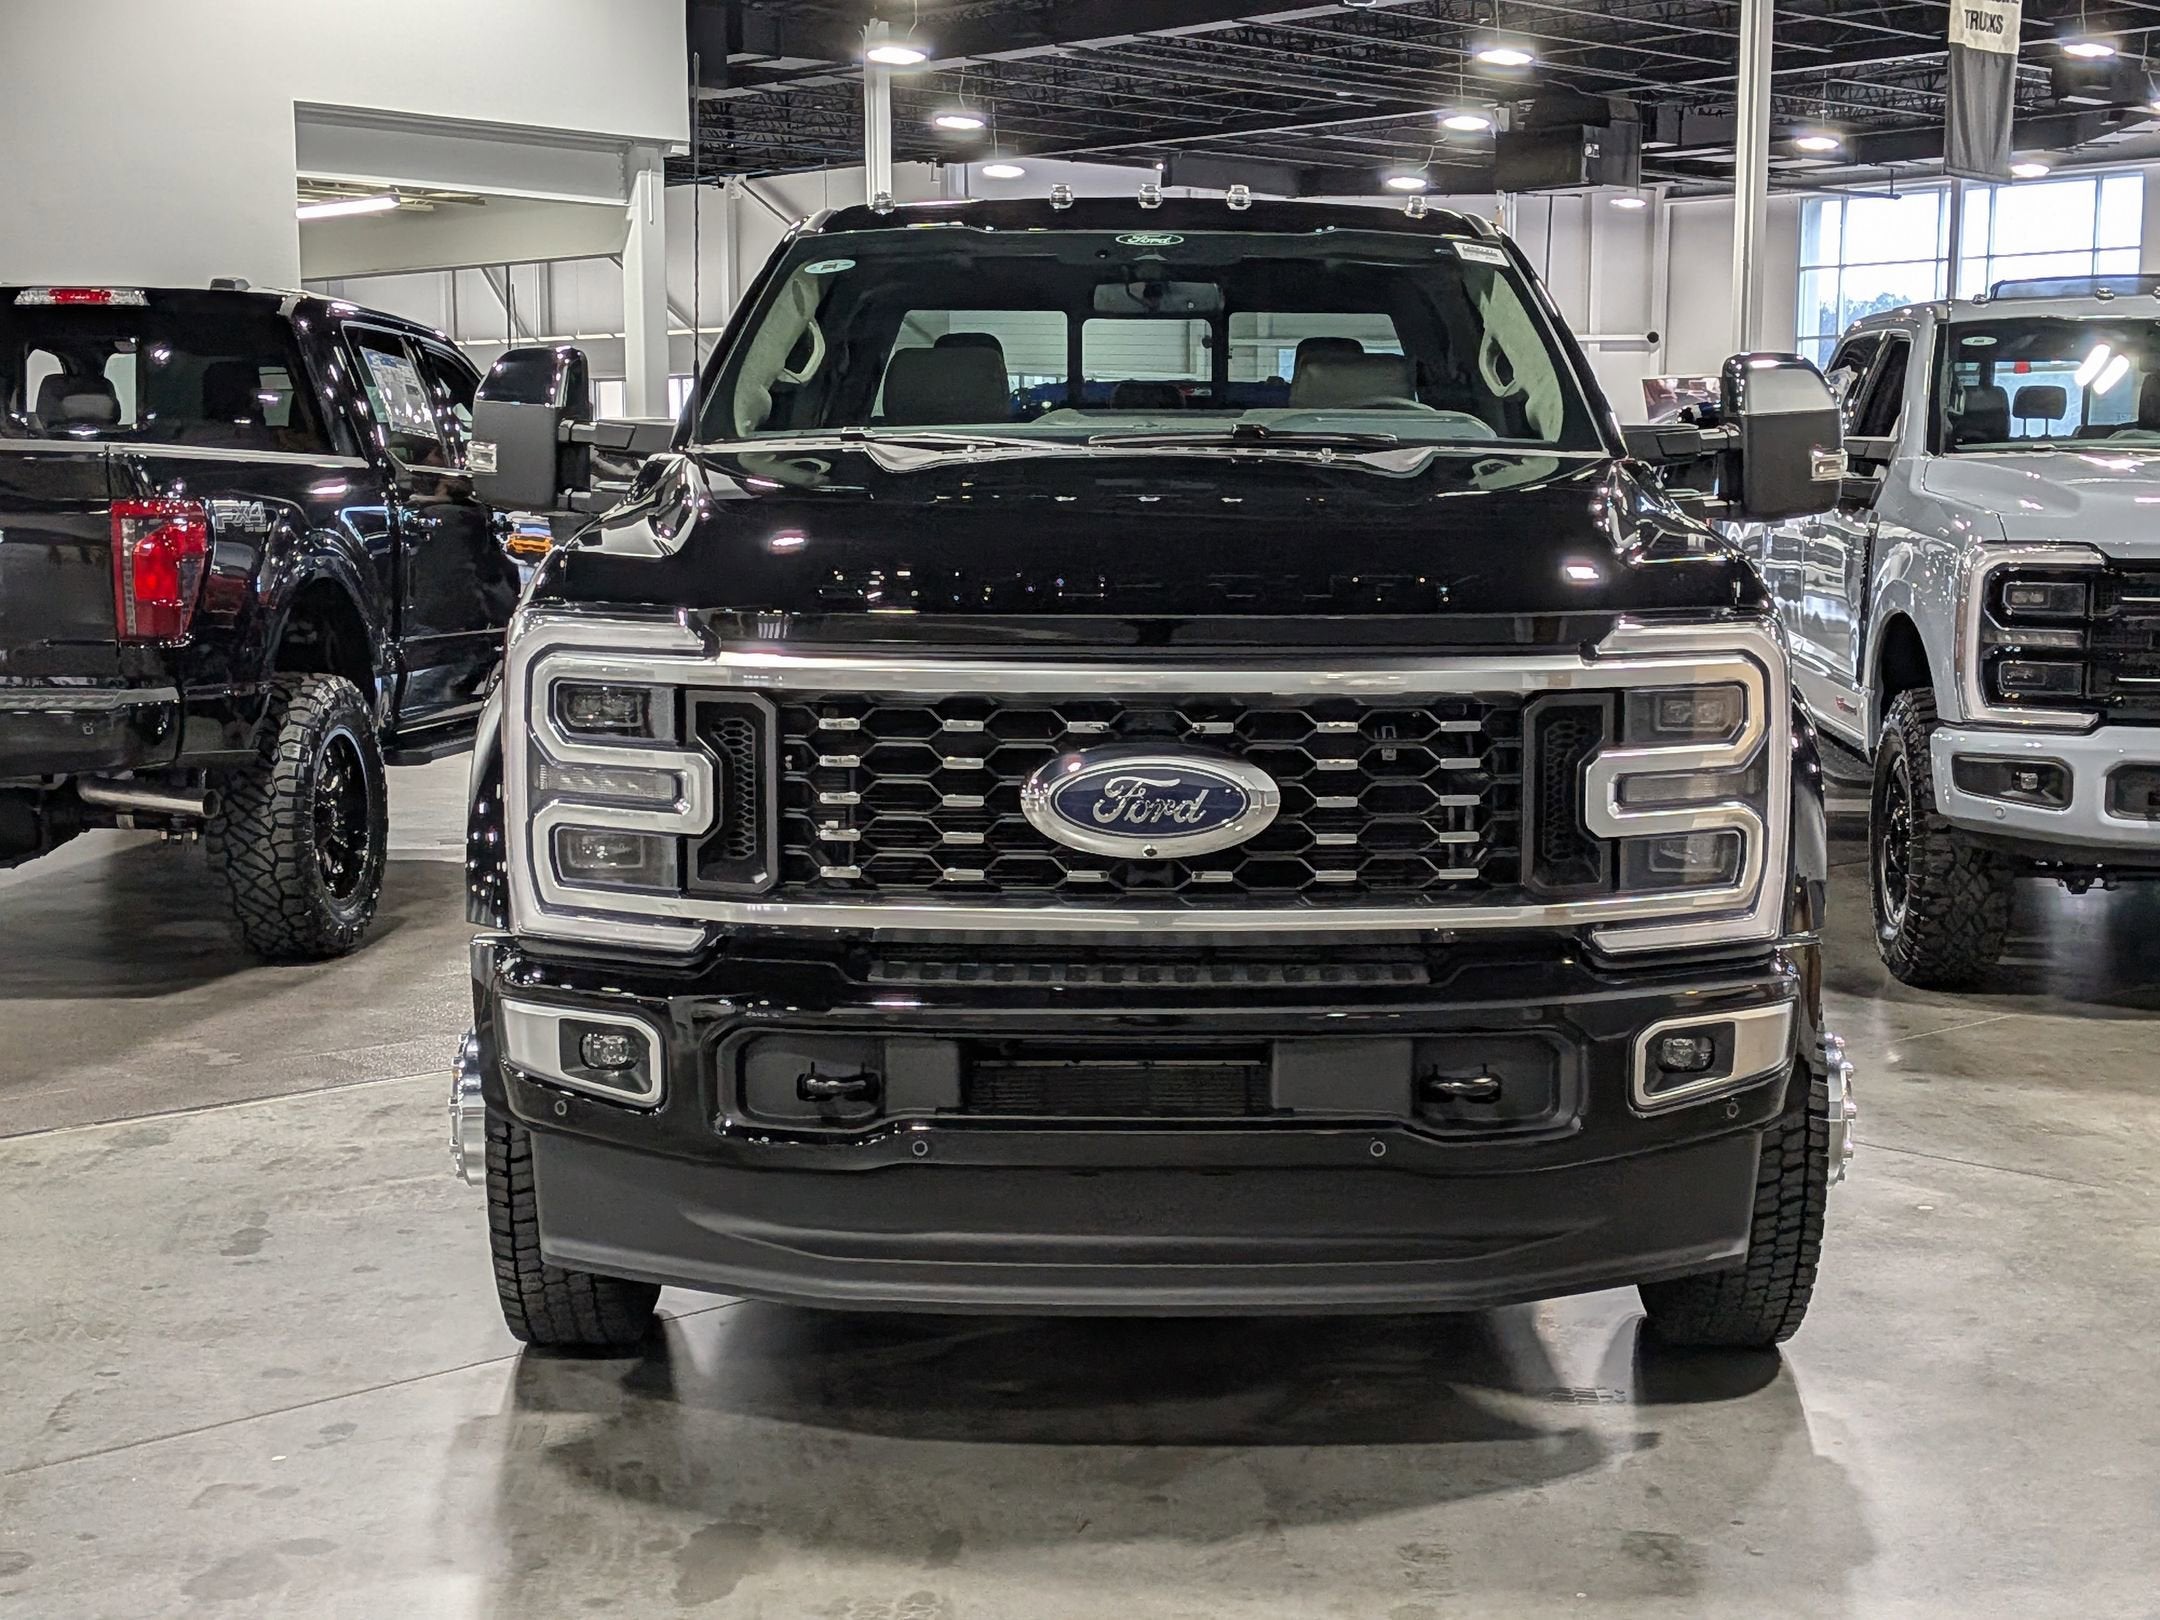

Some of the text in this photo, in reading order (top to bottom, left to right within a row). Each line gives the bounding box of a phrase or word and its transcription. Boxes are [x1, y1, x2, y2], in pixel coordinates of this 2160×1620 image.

[1127, 233, 1172, 245] Ford
[211, 500, 267, 532] FX4
[1092, 776, 1210, 824] Ford
